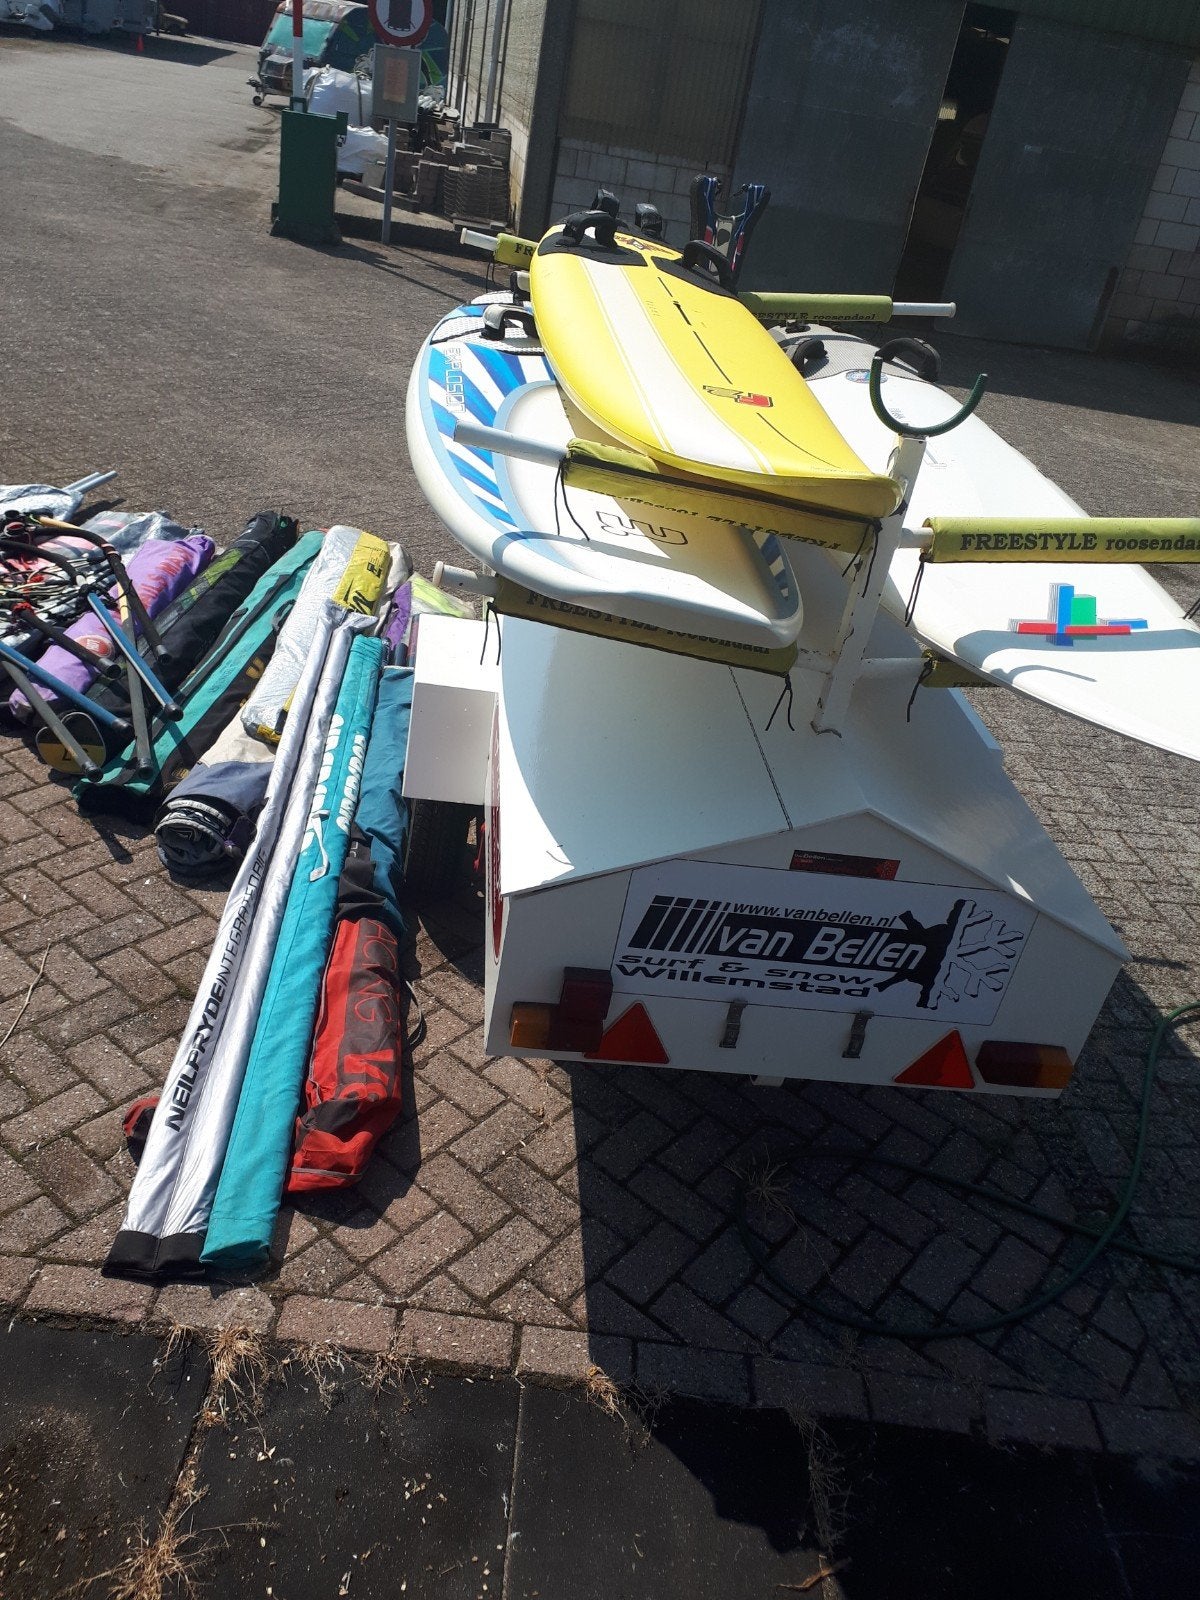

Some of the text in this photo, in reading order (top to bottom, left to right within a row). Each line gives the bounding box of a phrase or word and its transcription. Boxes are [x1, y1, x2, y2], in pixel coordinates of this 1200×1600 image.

[960, 533, 1098, 551] FREESTYLE
[733, 902, 898, 928] www.vanbellen.nl
[719, 926, 926, 970] van Bellen
[615, 964, 871, 998] Willemstad
[619, 954, 874, 985] surf & snow
[164, 983, 227, 1133] NEILPRYDE
